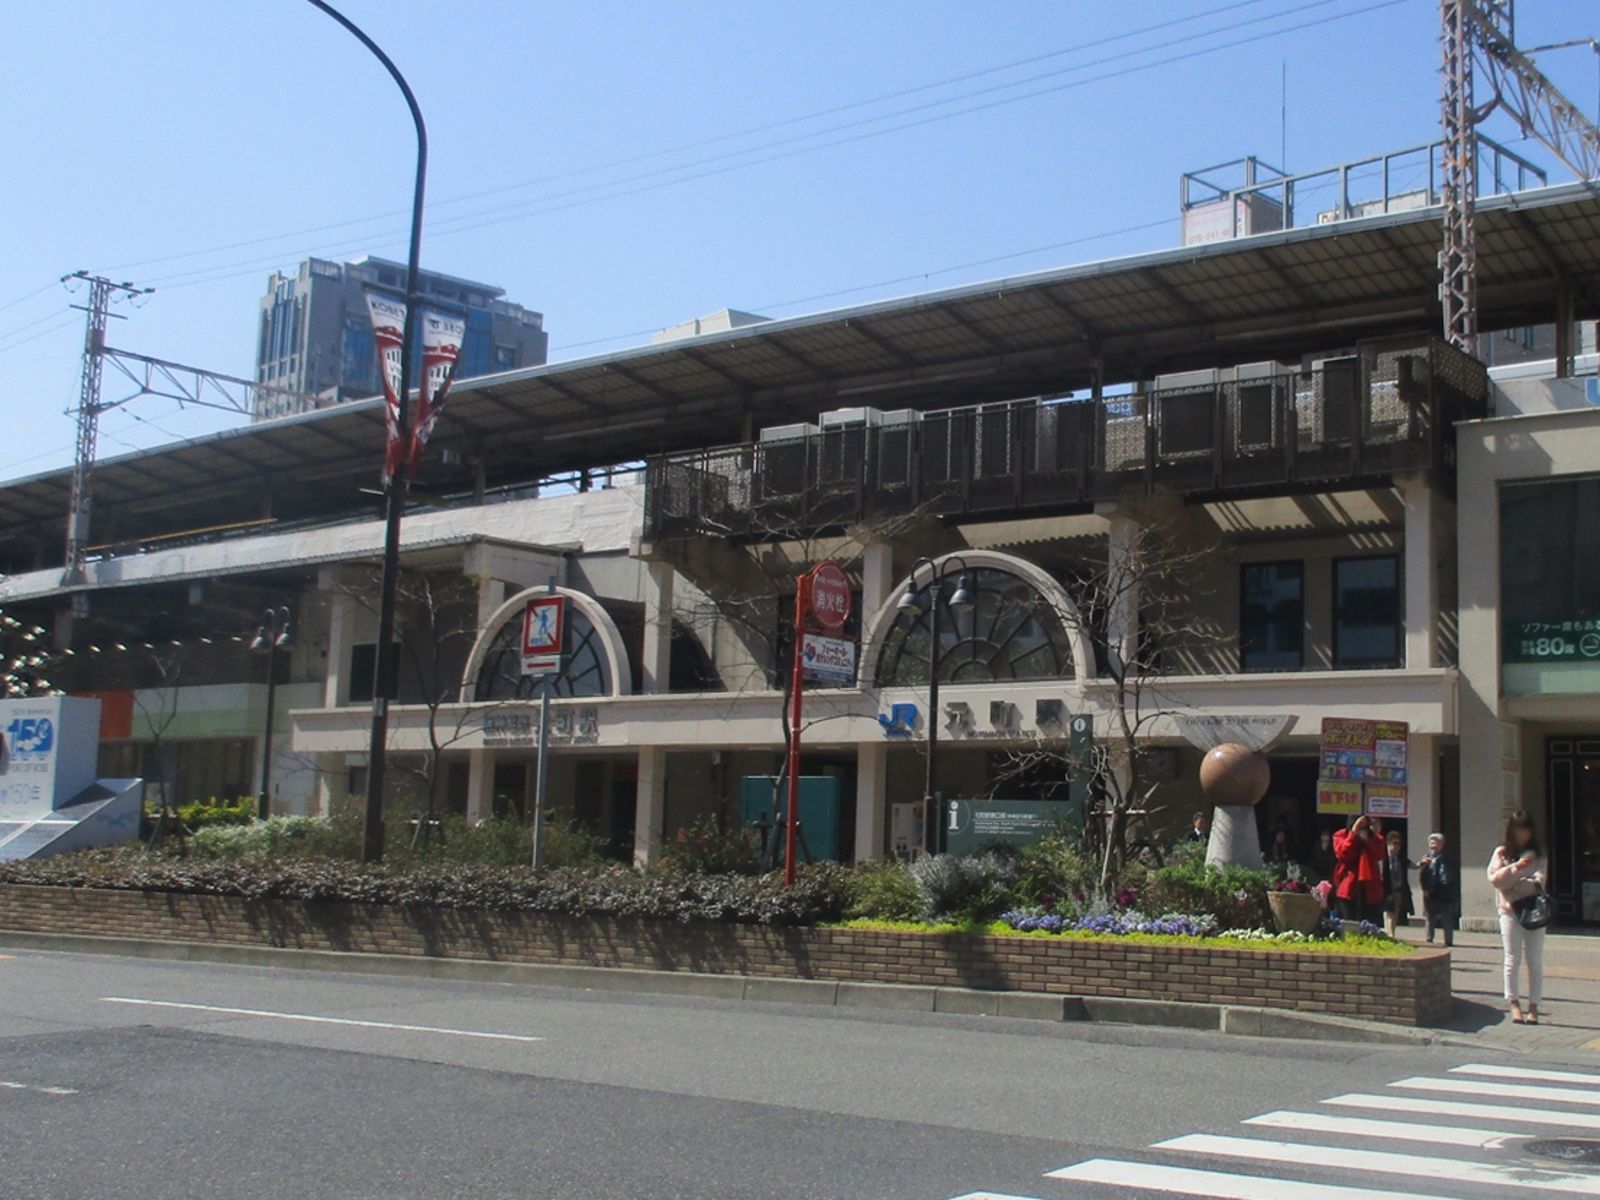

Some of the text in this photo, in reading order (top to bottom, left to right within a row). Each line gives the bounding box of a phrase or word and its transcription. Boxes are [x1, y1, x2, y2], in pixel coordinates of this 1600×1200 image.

[816, 590, 845, 613] 消火栓
[878, 701, 917, 737] JR
